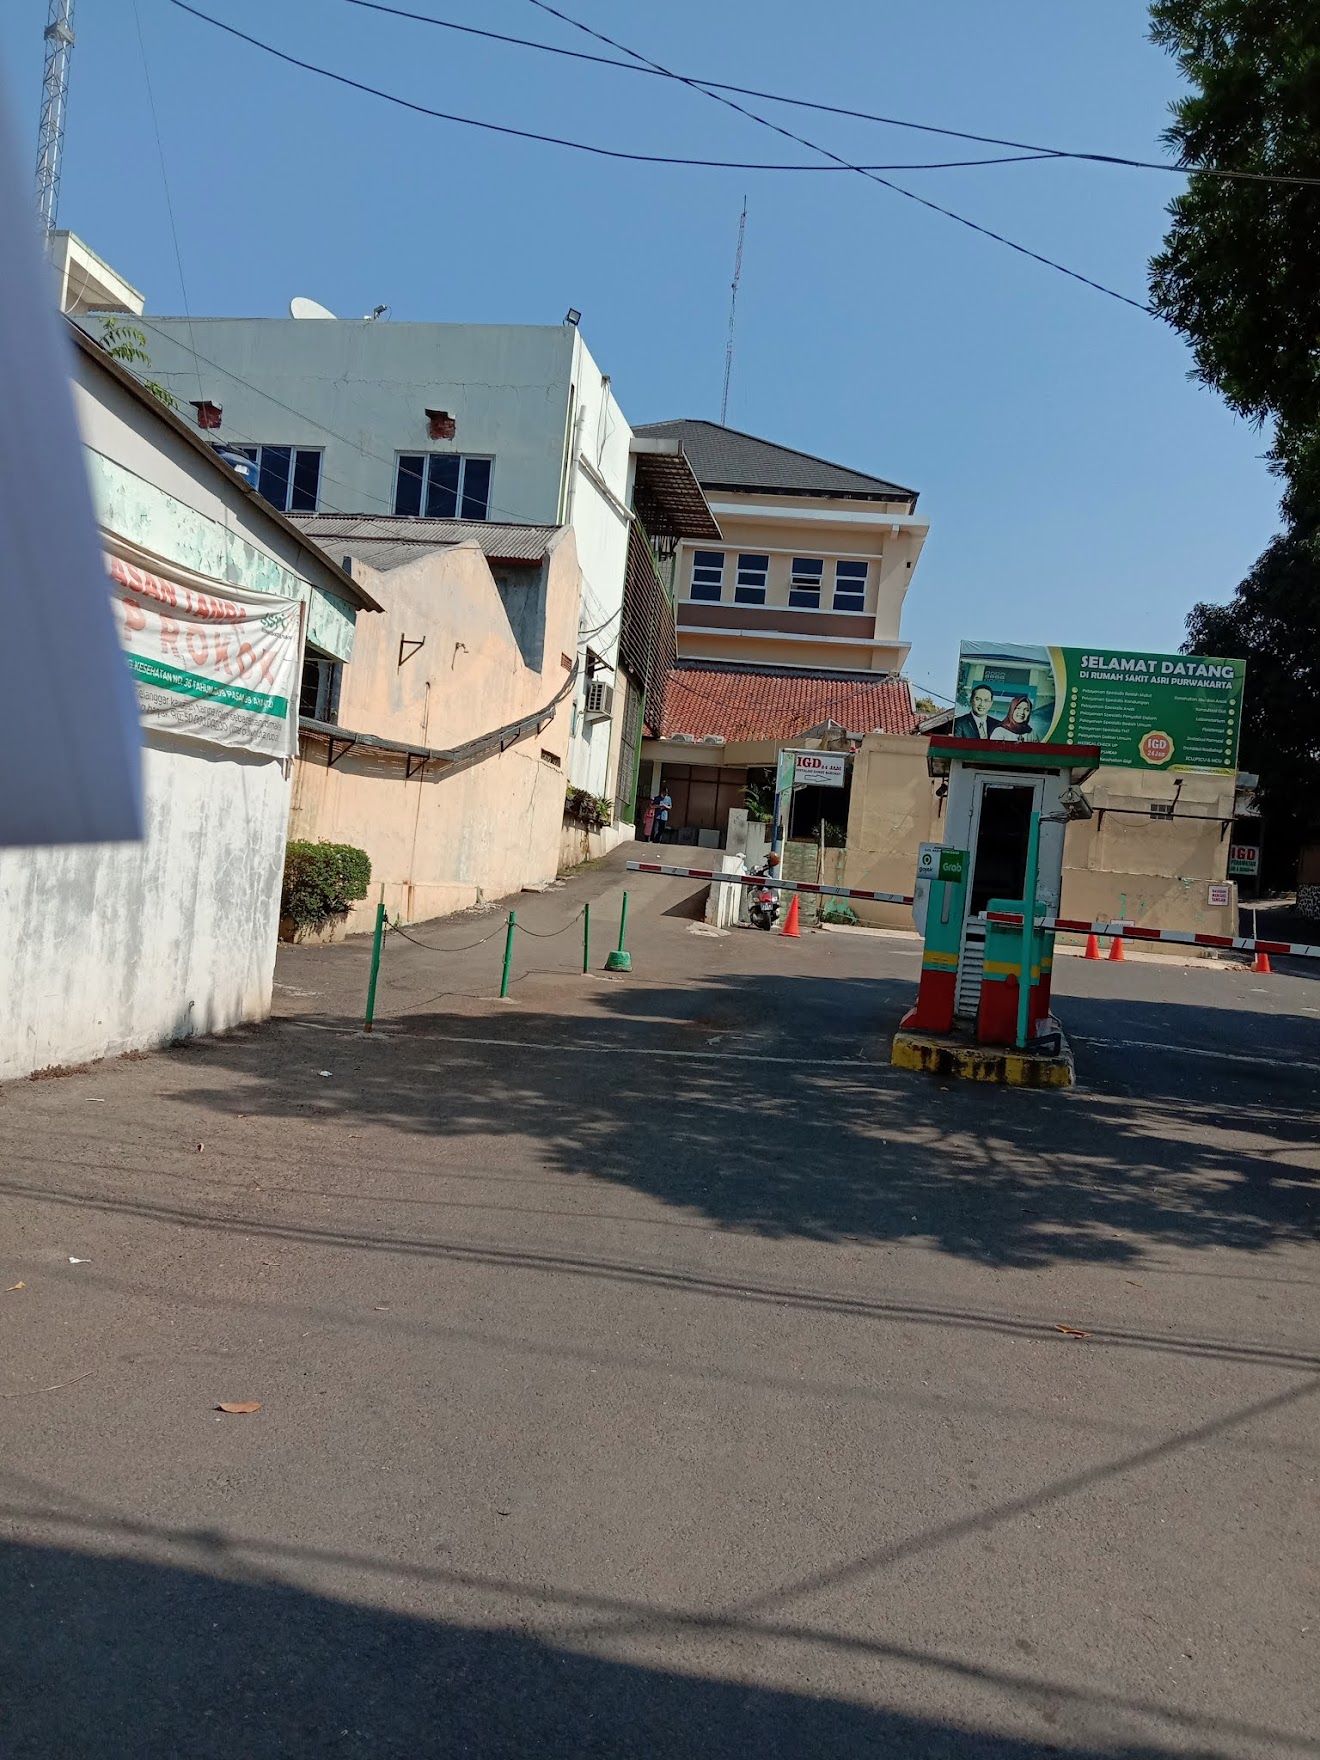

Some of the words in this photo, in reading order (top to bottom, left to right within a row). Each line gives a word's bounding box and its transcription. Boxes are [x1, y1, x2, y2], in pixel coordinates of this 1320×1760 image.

[111, 556, 177, 607] ASAN
[159, 611, 276, 686] ROKOK
[134, 661, 172, 682] KESEHATAN
[1080, 655, 1157, 673] SELAMAT
[1161, 660, 1234, 679] DATANG
[1080, 670, 1089, 679] DI
[1090, 671, 1124, 682] RUMAH
[1125, 673, 1149, 683] SAKIT
[1150, 675, 1169, 685] ASRI
[1171, 677, 1232, 690] PURWAKARTA
[1147, 739, 1167, 749] IGD
[796, 756, 822, 769] IGD
[1231, 847, 1256, 860] IGD
[942, 862, 962, 872] Grab
